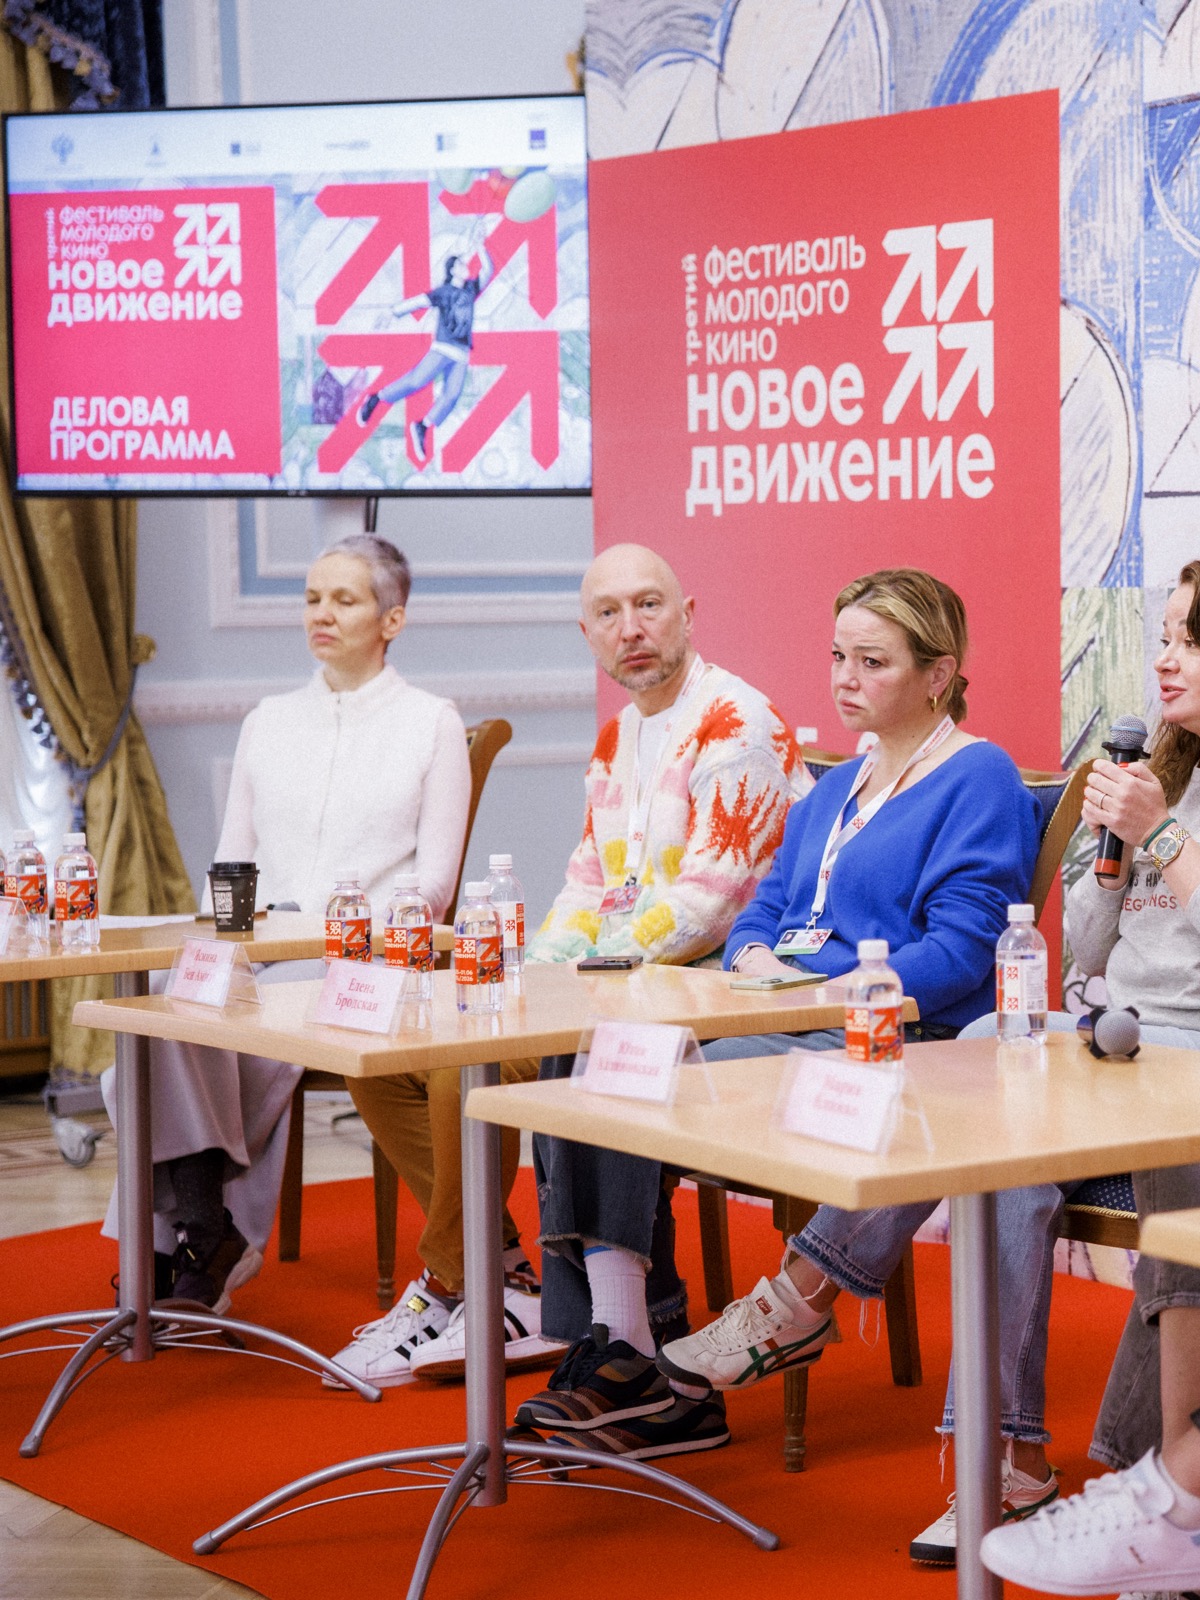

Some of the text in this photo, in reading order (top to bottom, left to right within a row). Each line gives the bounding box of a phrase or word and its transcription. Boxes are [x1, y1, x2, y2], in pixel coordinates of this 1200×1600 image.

[59, 205, 164, 226] фестиваль
[60, 223, 154, 244] молодого
[61, 242, 109, 260] кино
[704, 234, 866, 288] фестиваль
[48, 259, 165, 290] новое
[47, 290, 243, 328] движение
[681, 253, 702, 366] третий
[705, 279, 849, 326] молодого
[705, 327, 777, 366] кино
[50, 395, 189, 432] ДЕЛОВАЯ
[687, 362, 865, 433] новое
[50, 429, 236, 461] ПРОГРАММА
[685, 433, 995, 517] движение
[335, 992, 379, 1012] Бродская
[348, 977, 376, 994] Елена
